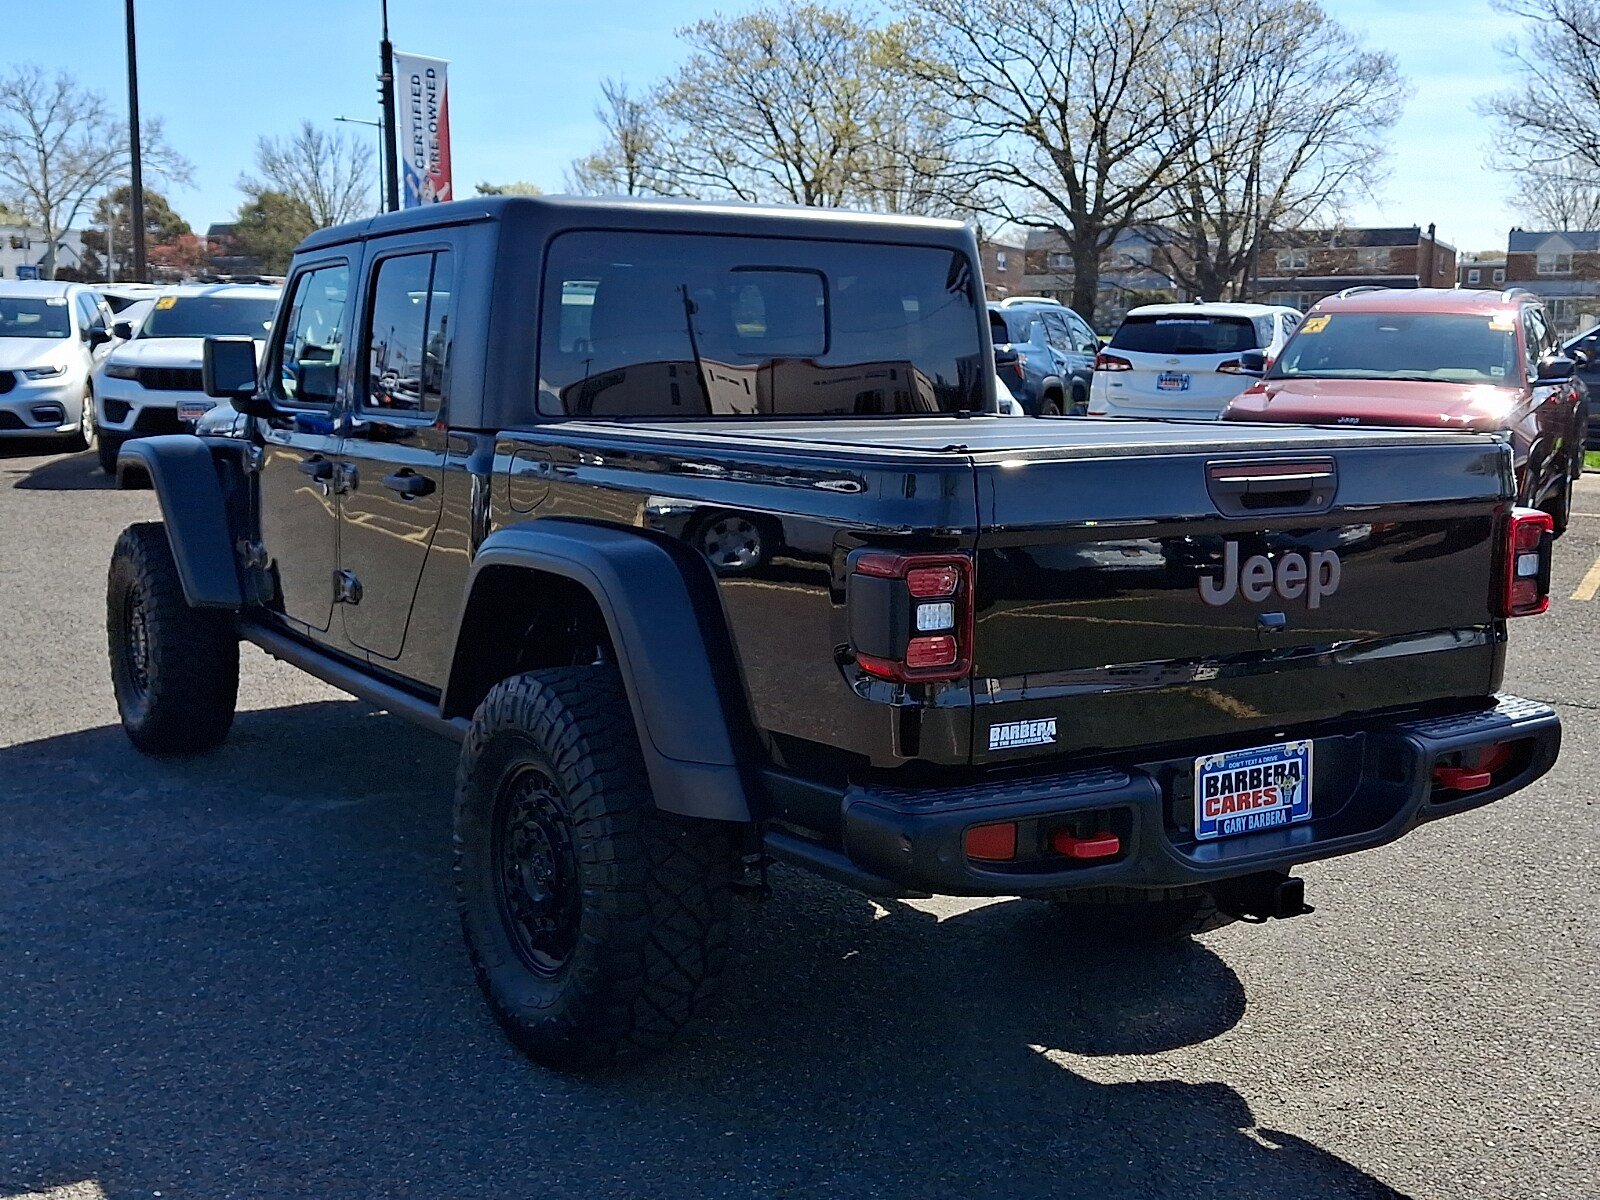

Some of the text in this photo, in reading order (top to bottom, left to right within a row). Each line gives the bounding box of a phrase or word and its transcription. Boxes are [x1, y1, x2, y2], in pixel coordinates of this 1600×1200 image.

[411, 74, 425, 169] CERTIFIED
[426, 68, 440, 174] PRE-OWNED
[1198, 540, 1341, 609] Jeep
[990, 721, 1056, 742] BARBERA
[1228, 760, 1244, 769] DON'T
[1245, 757, 1258, 767] TEXT
[1263, 755, 1279, 763] DRIVE
[1205, 761, 1301, 798] BARBERA
[1205, 787, 1278, 817] CARES
[1224, 809, 1287, 834] GARY BARBERA
